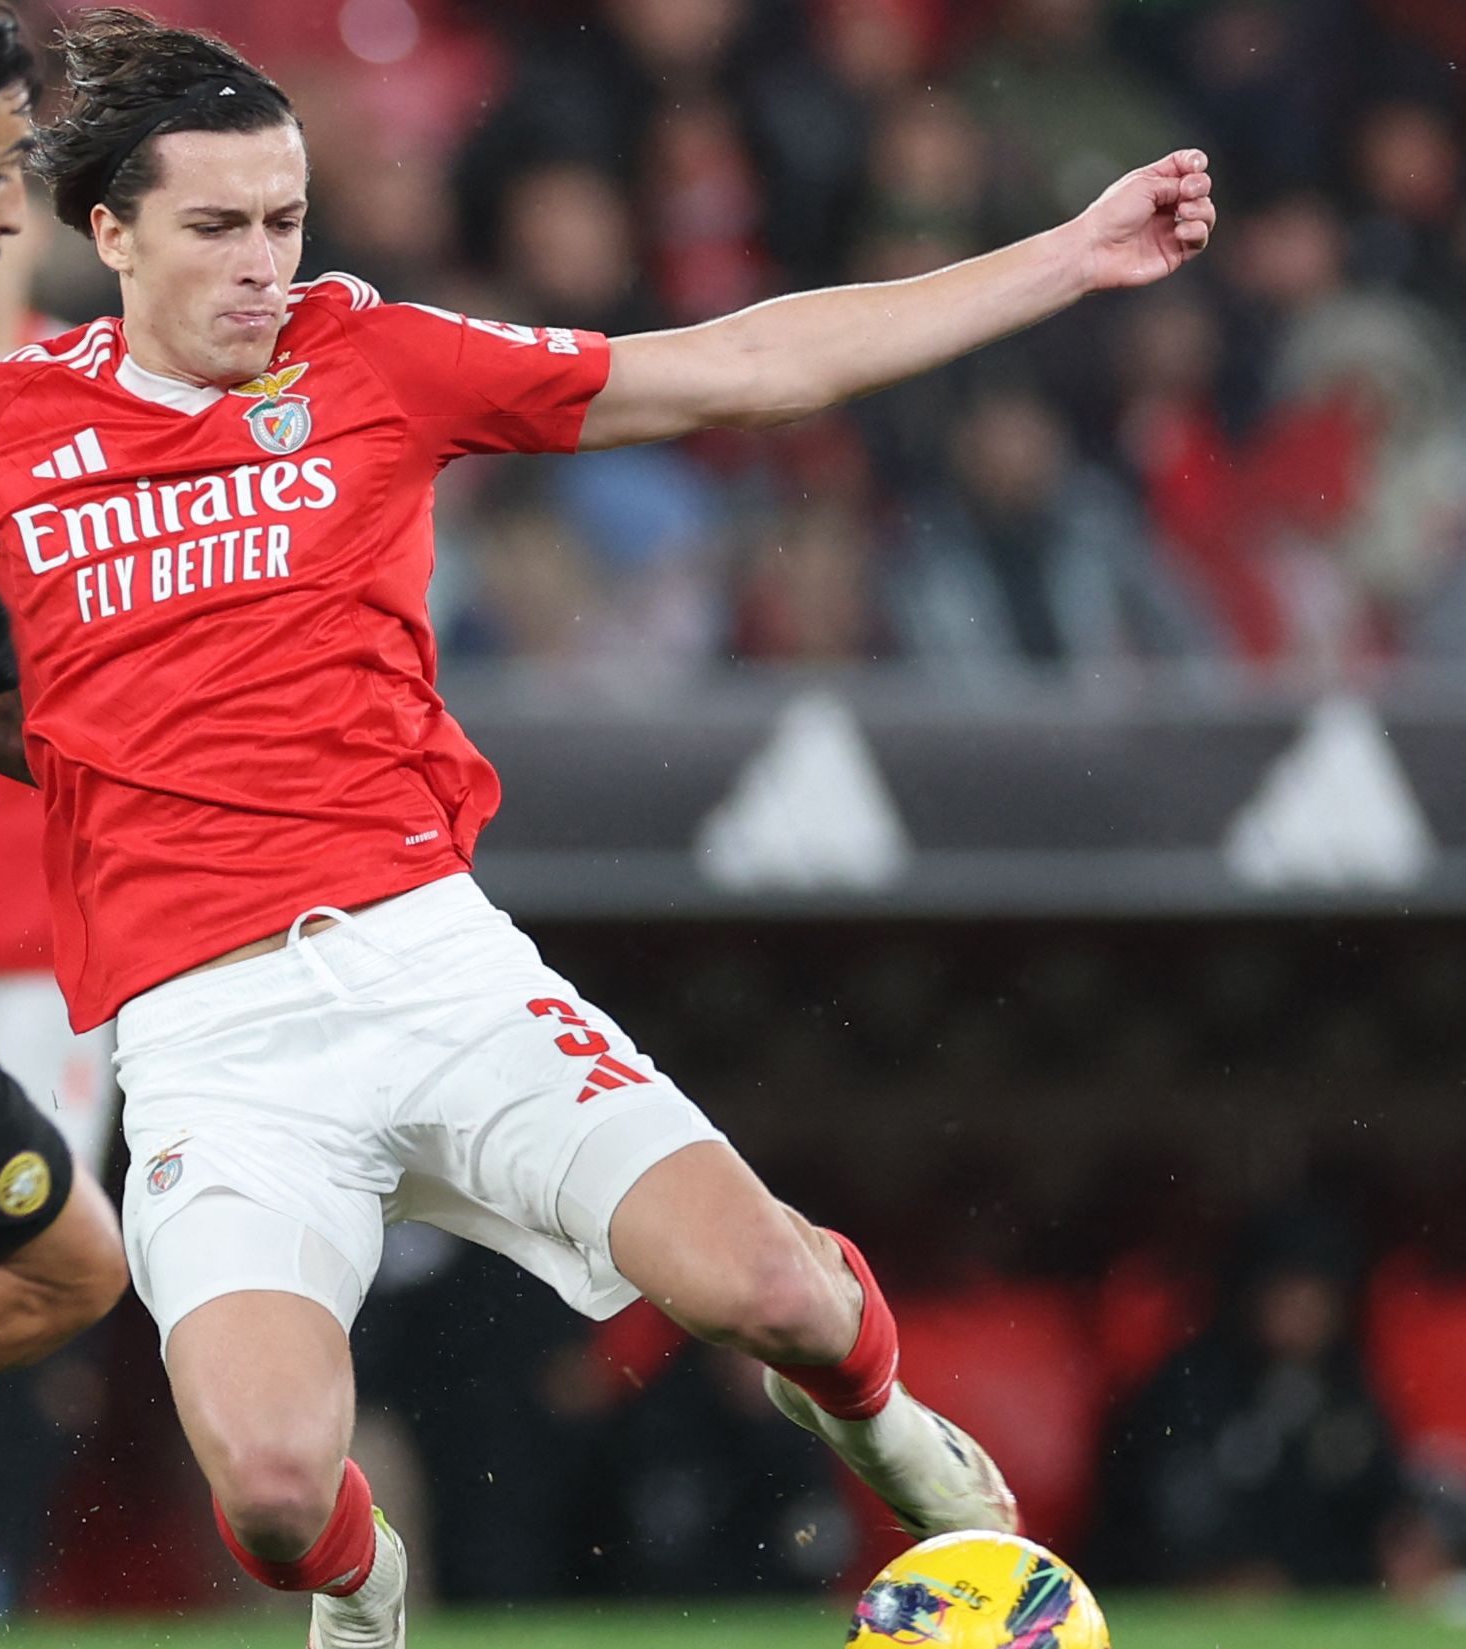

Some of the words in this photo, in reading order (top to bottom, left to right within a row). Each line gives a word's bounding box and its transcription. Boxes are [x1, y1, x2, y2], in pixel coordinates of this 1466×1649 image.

[11, 457, 337, 575] Emirates
[75, 554, 135, 624] FLY
[150, 523, 291, 603] BETTER
[526, 997, 610, 1056] 3
